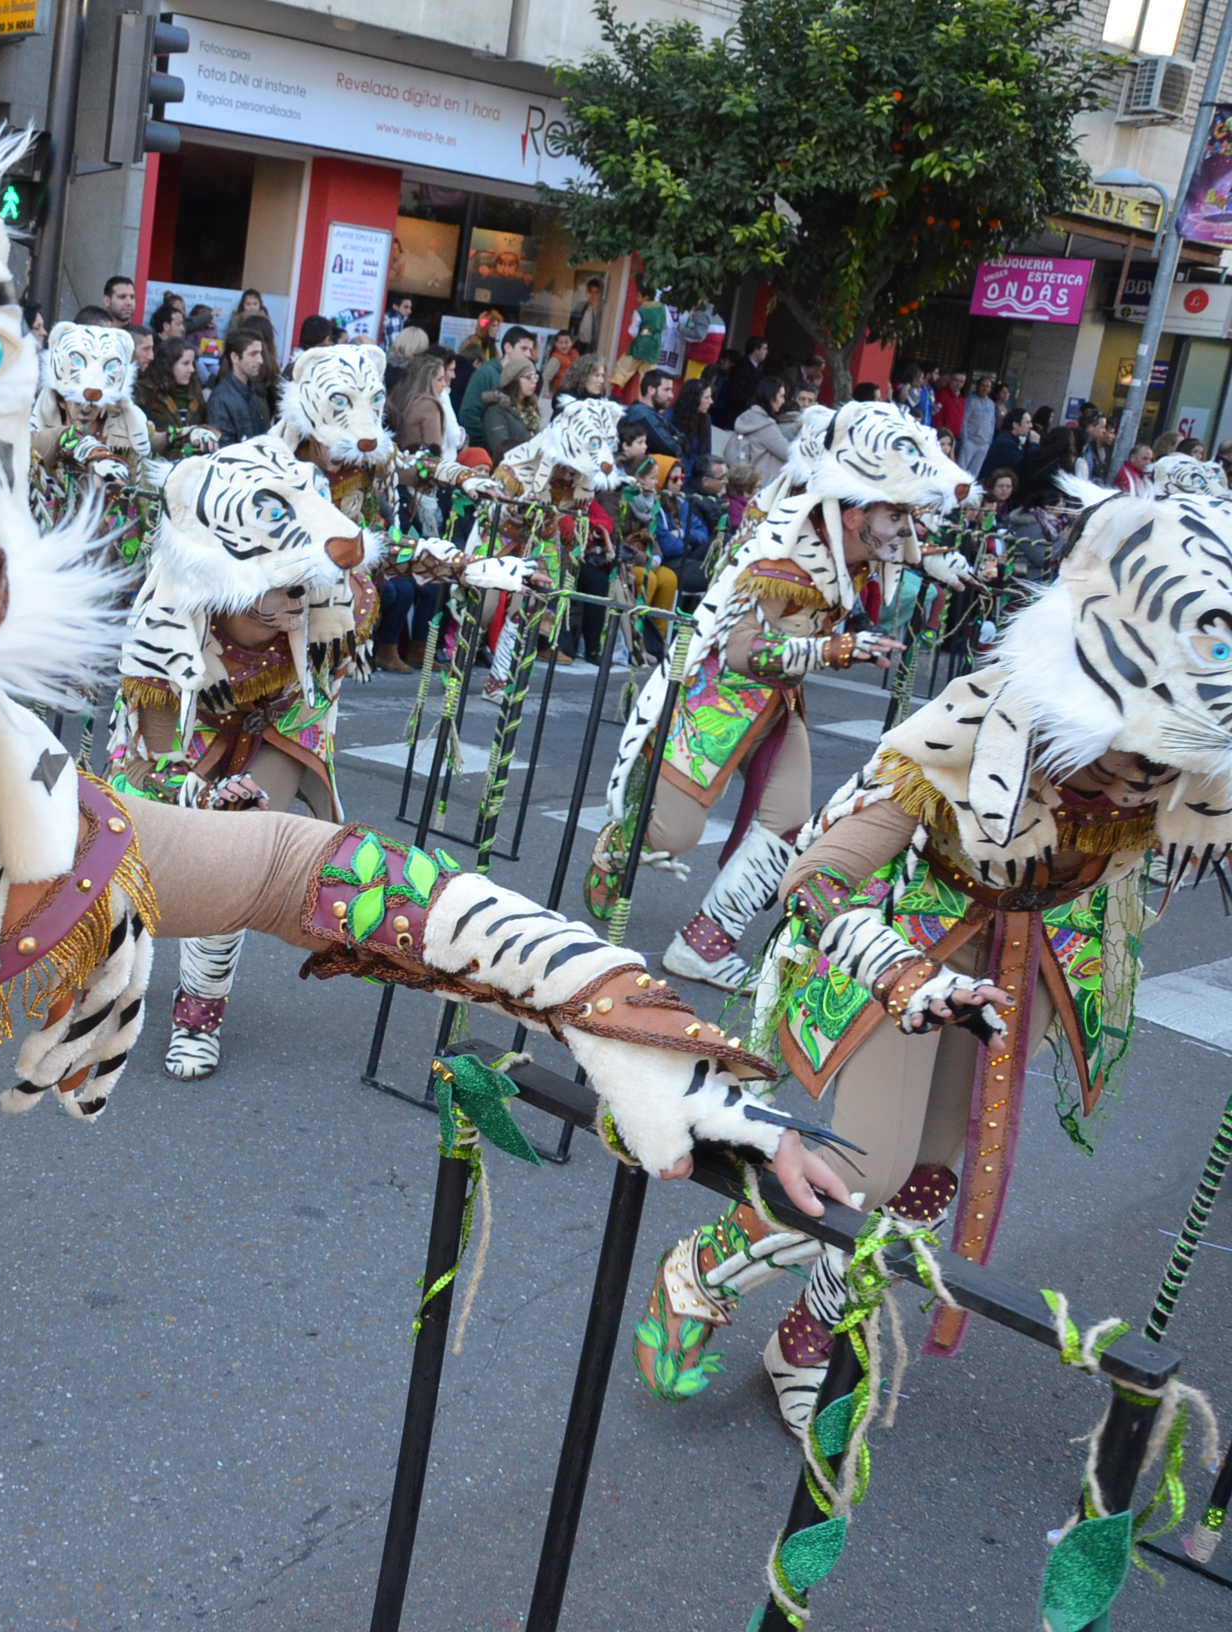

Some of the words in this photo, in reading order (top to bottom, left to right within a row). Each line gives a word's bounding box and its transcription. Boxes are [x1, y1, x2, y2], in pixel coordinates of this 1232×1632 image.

[199, 40, 251, 61] Fotocopias
[198, 64, 227, 82] Fotos
[230, 71, 249, 86] DNI
[252, 78, 263, 89] al
[265, 77, 307, 98] instante
[196, 91, 233, 108] Regalos
[235, 101, 302, 121] personalizados
[336, 72, 399, 99] Revelado
[402, 88, 441, 107] digital
[444, 98, 460, 112] en
[464, 100, 469, 113] 1
[472, 103, 500, 121] hora
[984, 257, 1054, 272] ELUQUERIA
[1026, 271, 1084, 287] ESTETICA
[1124, 279, 1153, 296] BBV
[986, 281, 1069, 305] ONDAS
